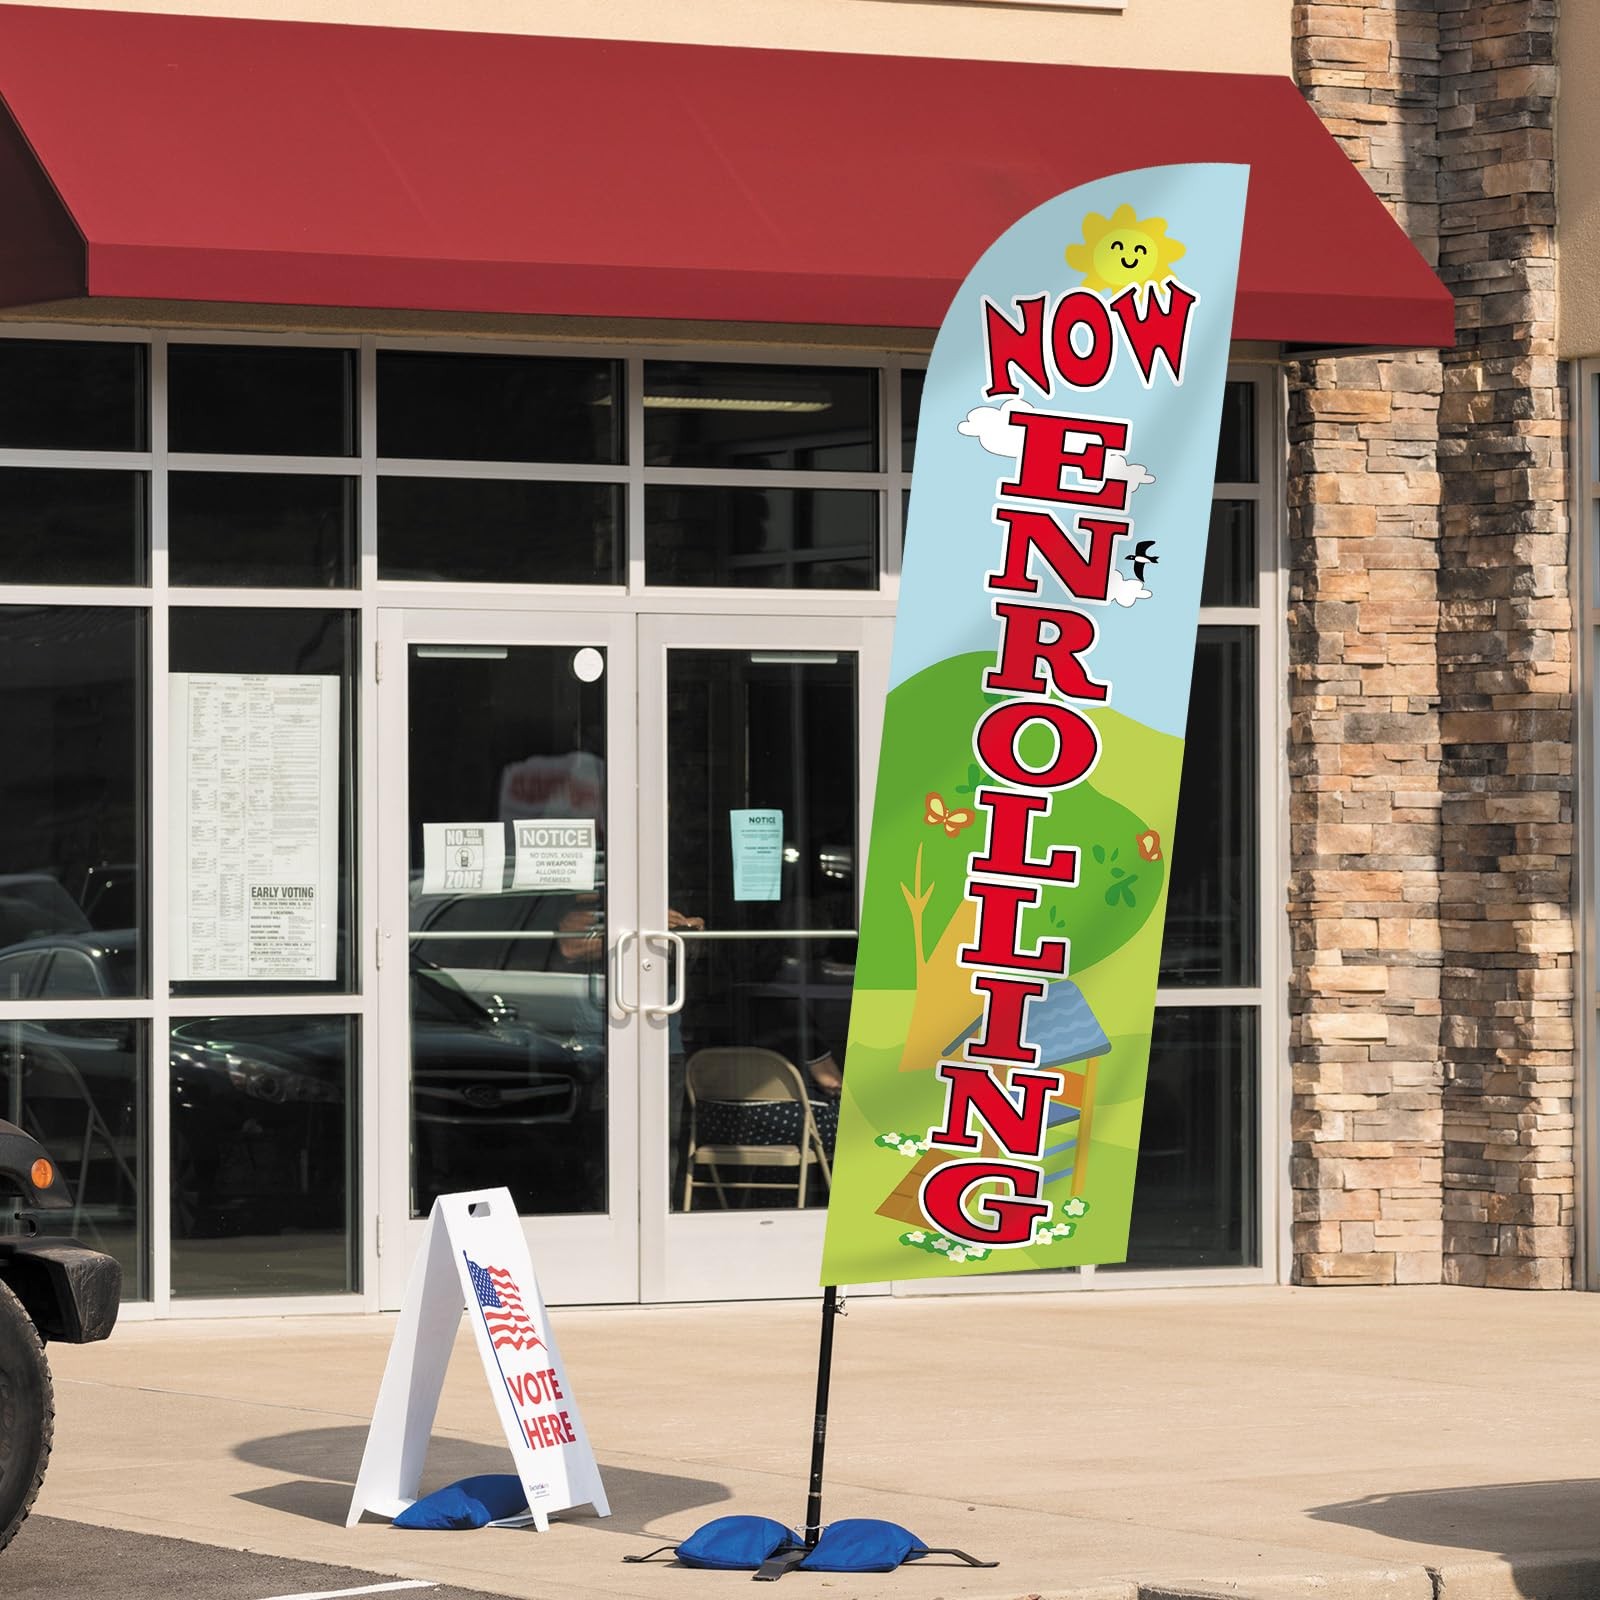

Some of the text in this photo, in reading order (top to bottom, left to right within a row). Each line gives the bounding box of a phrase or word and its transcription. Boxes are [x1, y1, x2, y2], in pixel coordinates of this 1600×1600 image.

[980, 276, 1200, 401] NOW
[748, 816, 776, 824] NOTICE
[919, 409, 1133, 1249] ENROLLING
[446, 829, 464, 846] NO
[522, 829, 589, 847] NOTICE
[446, 871, 482, 888] ZONE
[251, 886, 314, 898] EARLY VOTING
[506, 1368, 564, 1407] VOTE
[523, 1411, 577, 1450] HERE
